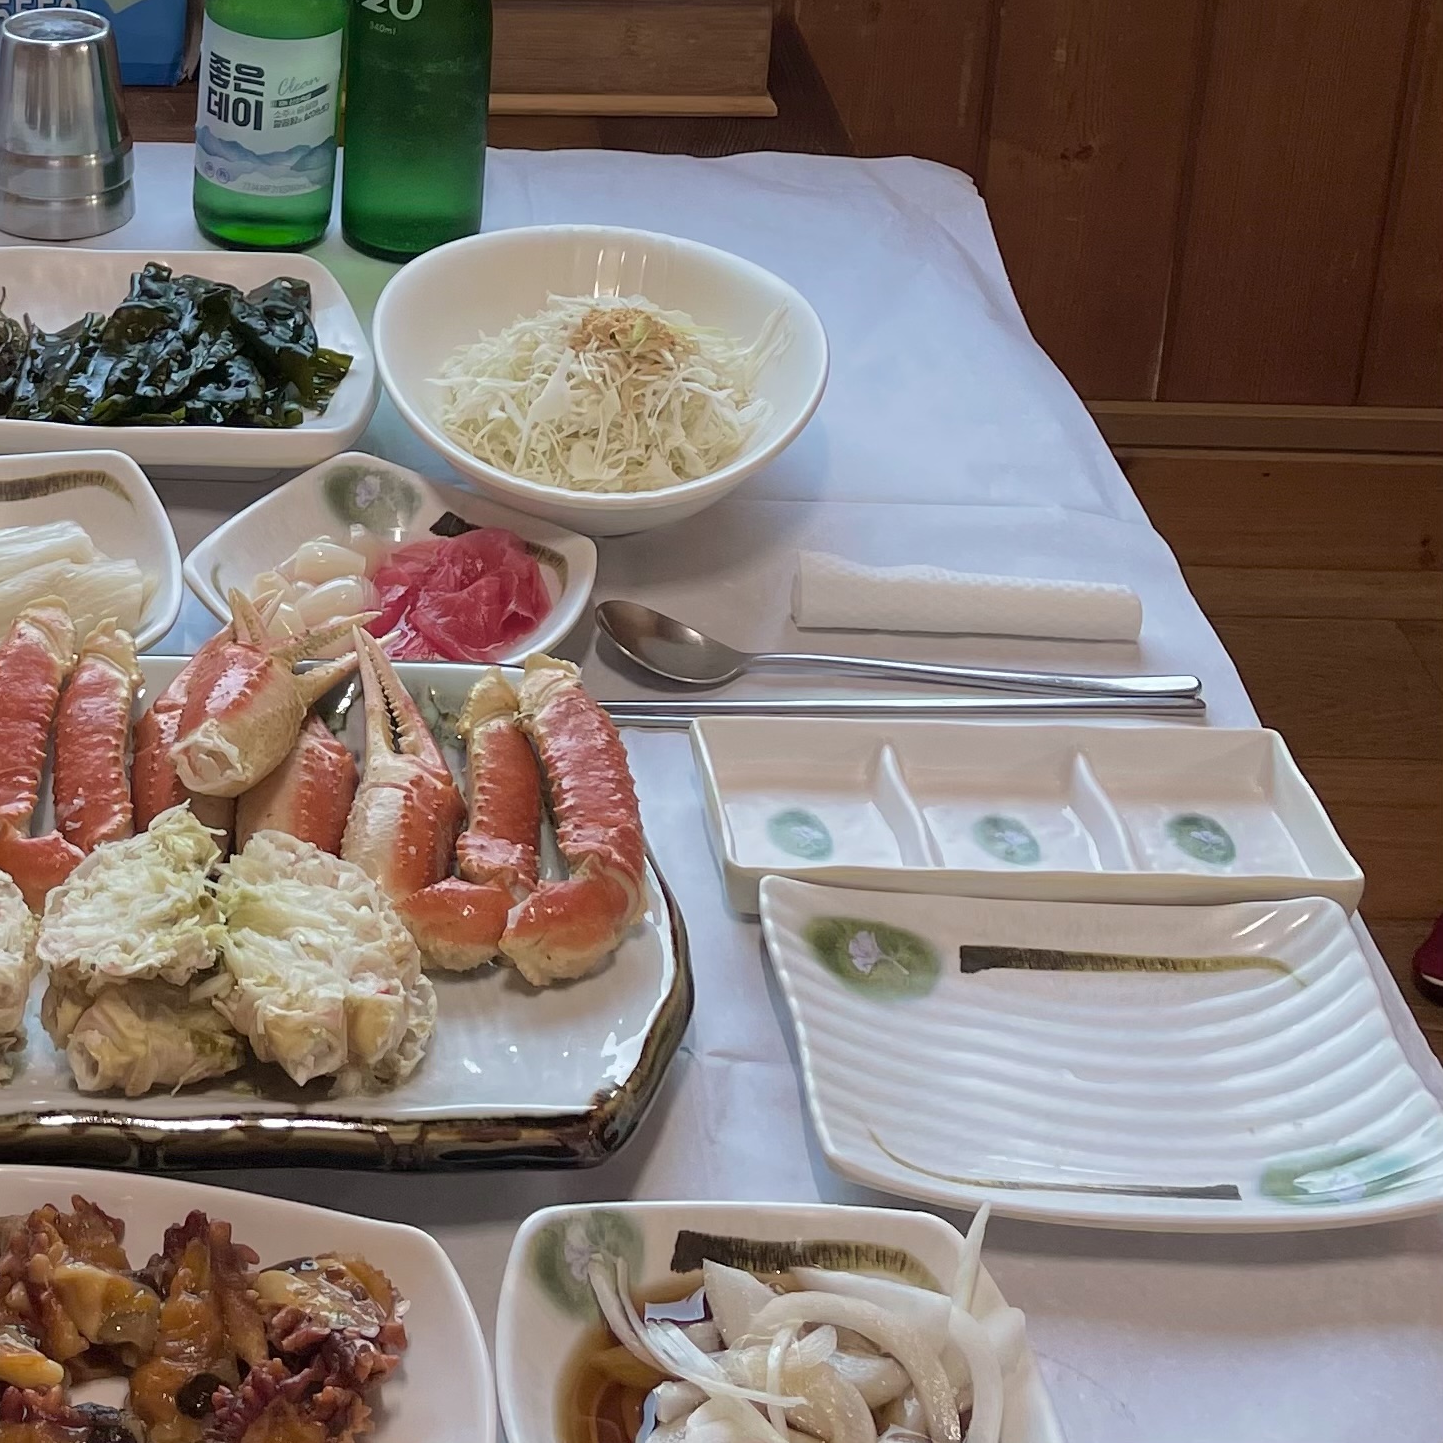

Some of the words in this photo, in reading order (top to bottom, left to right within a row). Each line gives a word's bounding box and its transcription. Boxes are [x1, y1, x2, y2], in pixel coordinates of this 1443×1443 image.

[209, 51, 265, 97] 좋은
[278, 77, 320, 96] Clean
[207, 86, 263, 131] 데이
